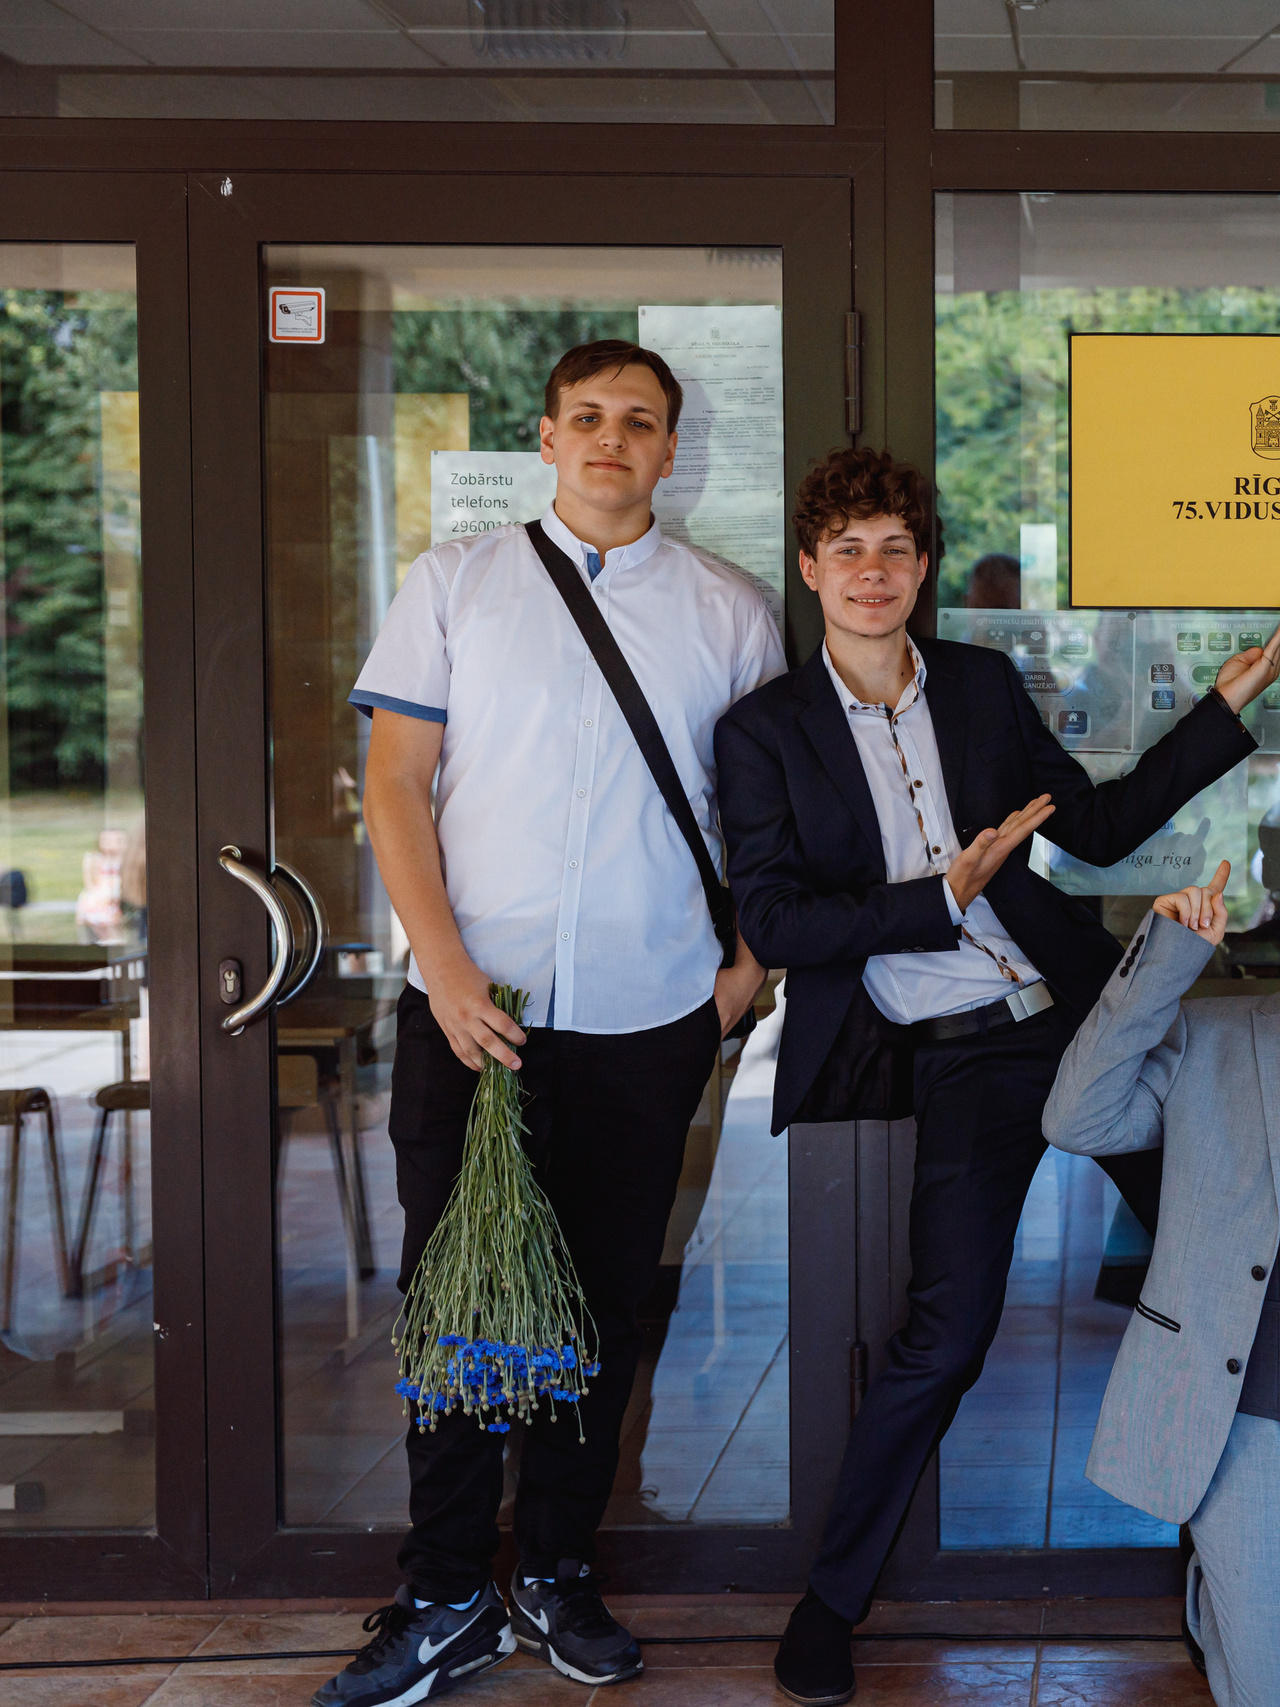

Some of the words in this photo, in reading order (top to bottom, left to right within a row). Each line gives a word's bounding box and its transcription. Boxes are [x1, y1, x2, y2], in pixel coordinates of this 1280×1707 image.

[451, 473, 513, 486] Zobārstu
[451, 495, 509, 508] telefons
[1023, 681, 1057, 689] GANIZĒJOT
